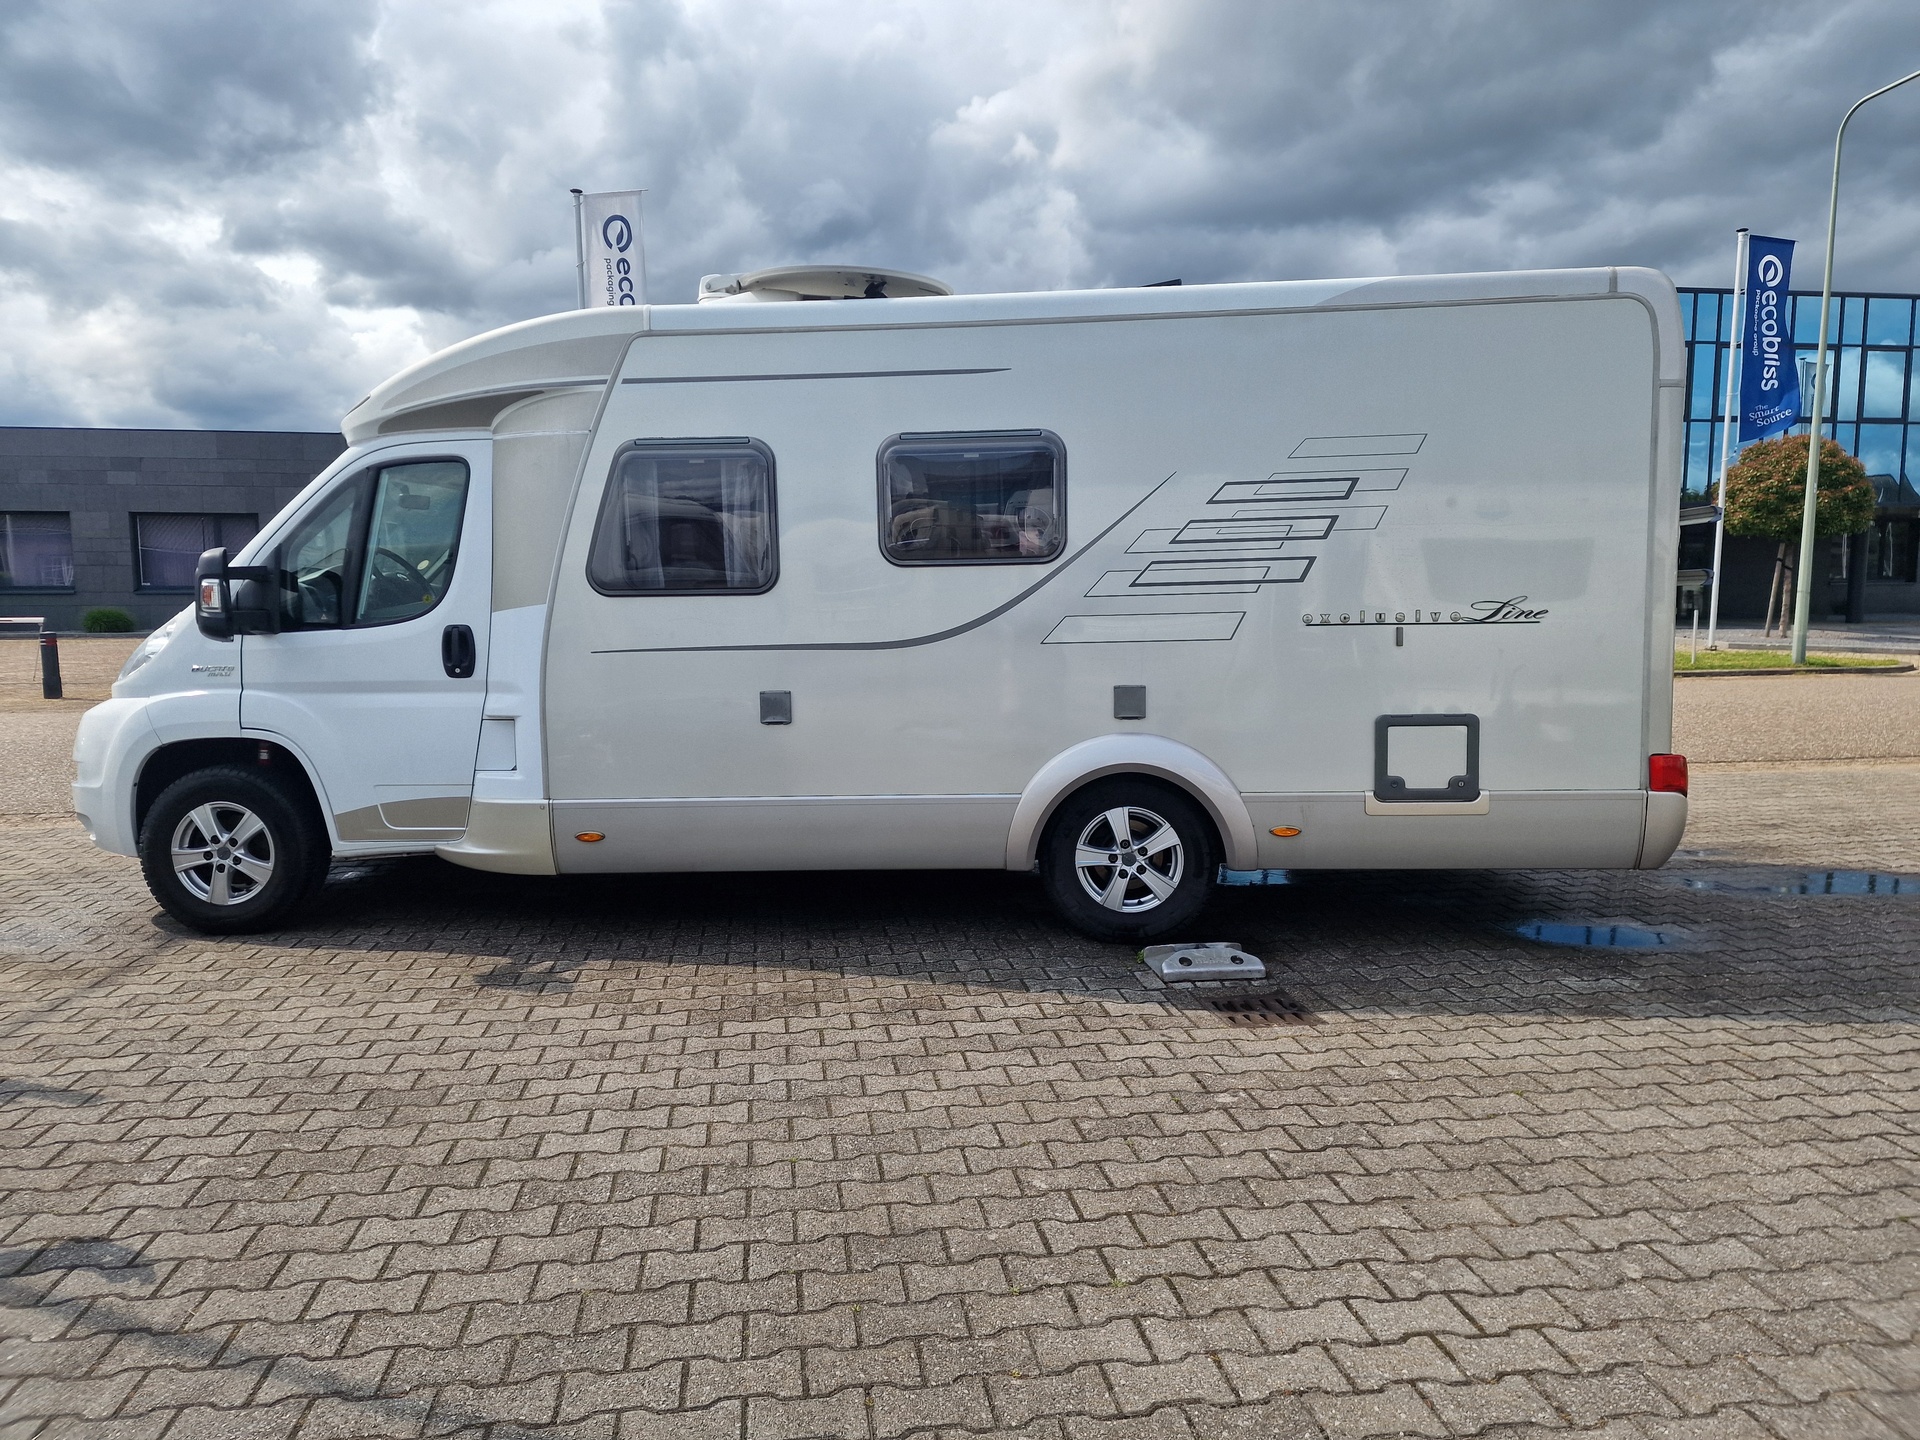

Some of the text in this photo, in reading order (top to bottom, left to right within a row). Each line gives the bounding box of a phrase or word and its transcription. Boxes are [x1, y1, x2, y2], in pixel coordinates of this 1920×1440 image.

[604, 258, 617, 306] packaging
[1753, 289, 1761, 331] packaging
[1761, 290, 1781, 391] ecobliss
[1749, 405, 1780, 421] Smart
[1755, 404, 1769, 412] The
[1757, 408, 1792, 427] Source
[1302, 595, 1549, 624] exclusive Line
